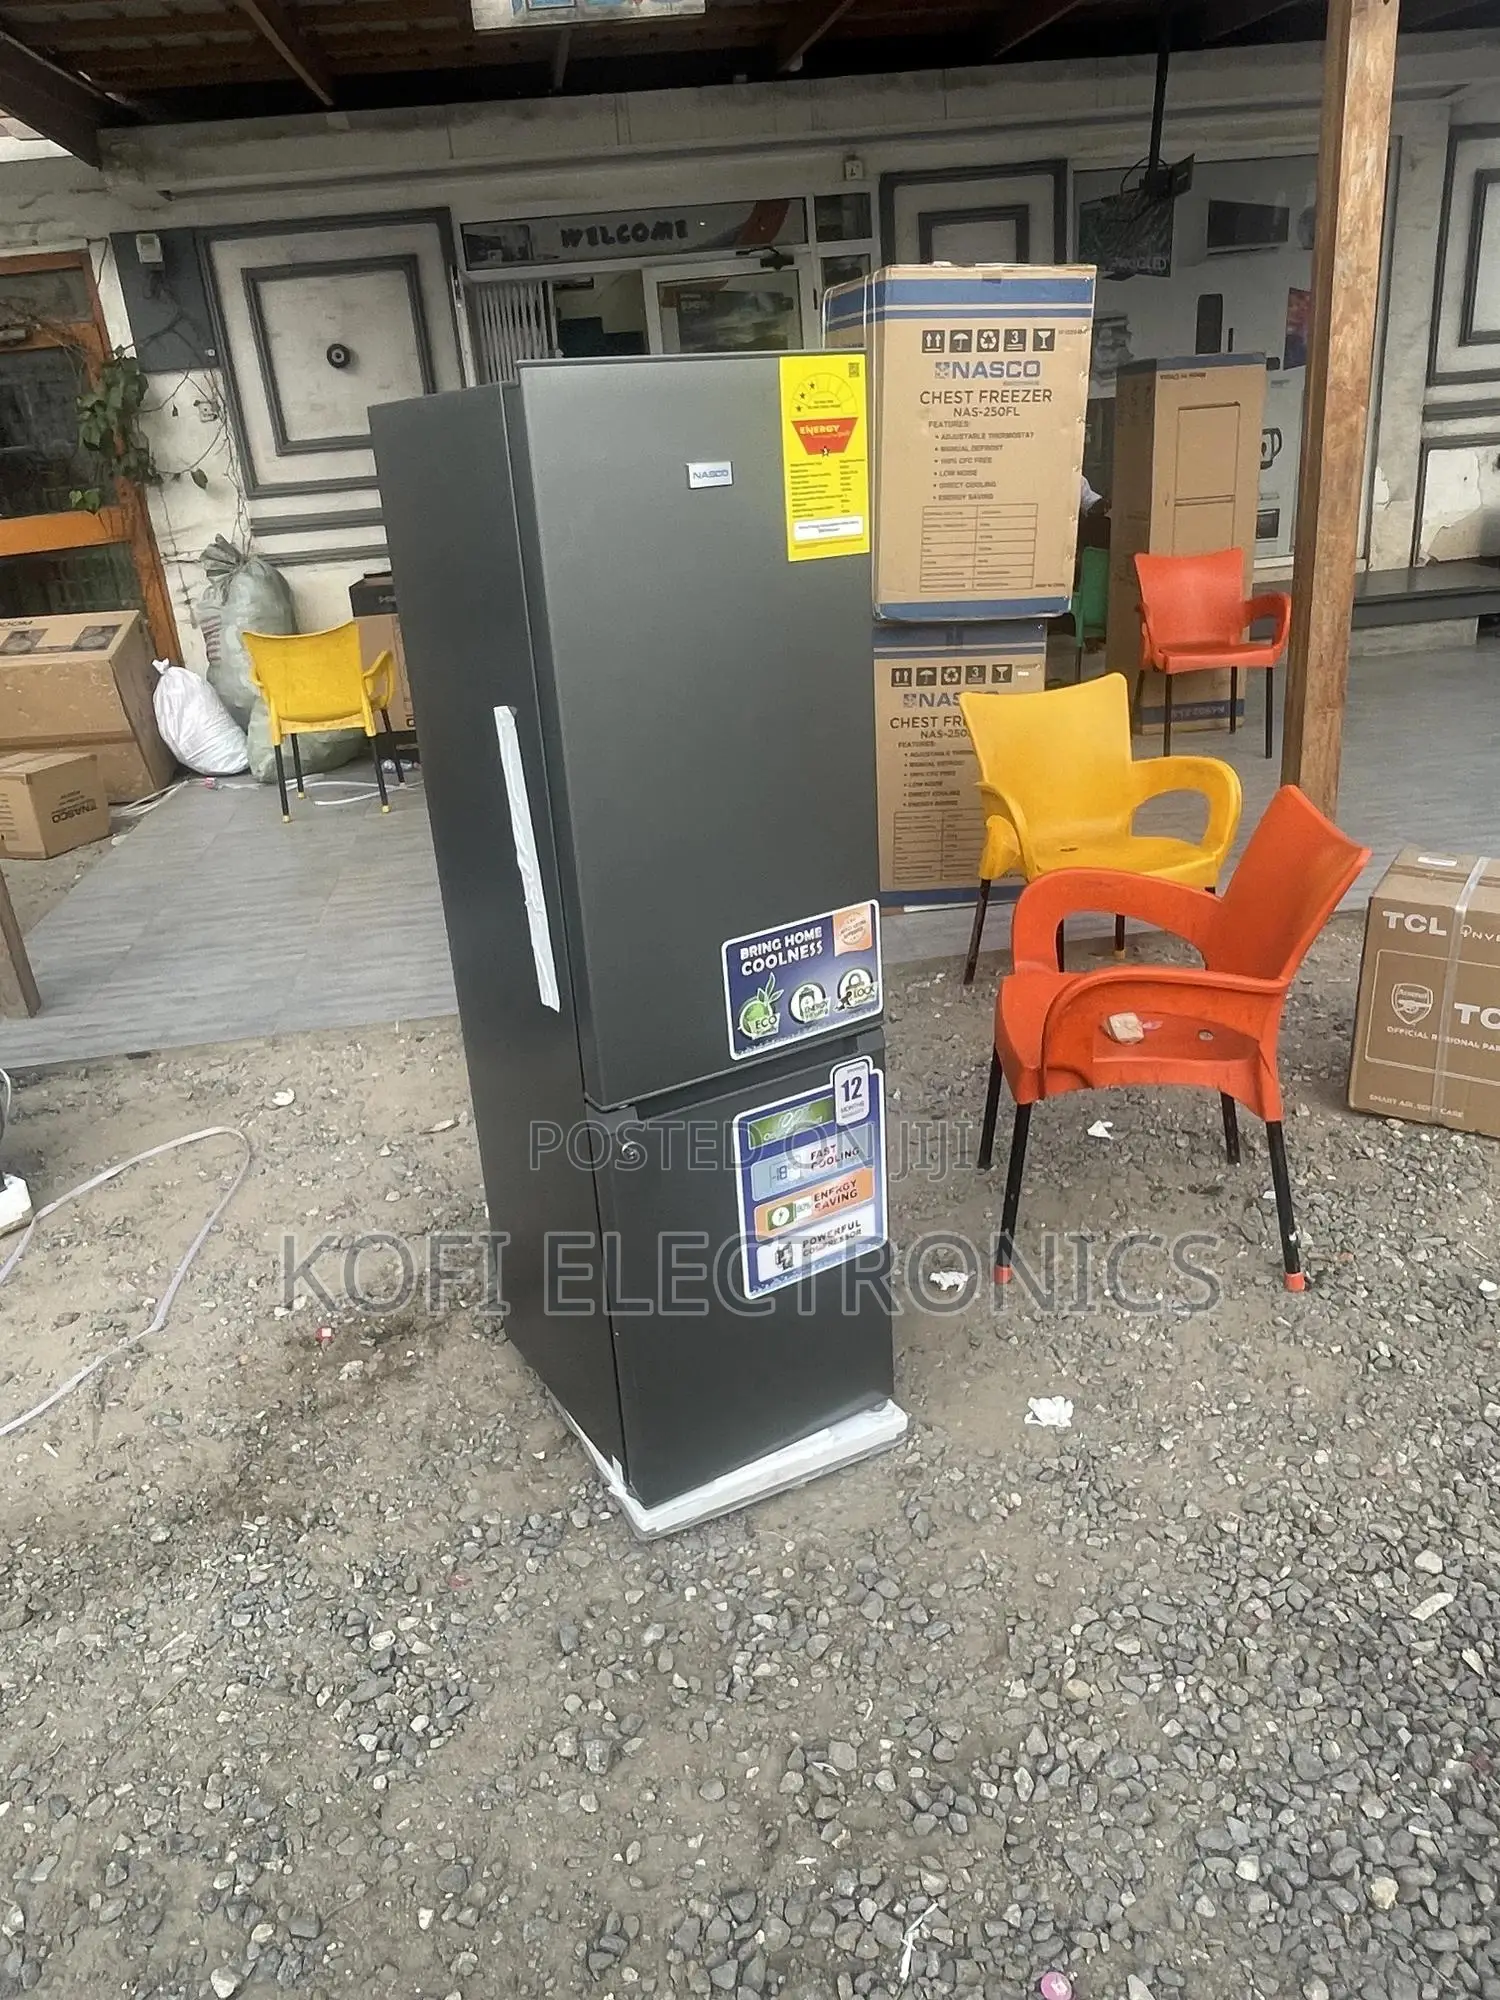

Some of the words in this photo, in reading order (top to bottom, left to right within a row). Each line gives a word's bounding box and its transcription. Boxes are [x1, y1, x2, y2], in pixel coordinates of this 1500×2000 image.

[560, 219, 688, 248] WELCOME
[952, 360, 1041, 379] NASCO
[920, 390, 974, 405] CHEST
[979, 388, 1053, 403] FREEZER
[953, 406, 1021, 418] NAS-250FL
[799, 424, 841, 436] ENERGY
[693, 469, 729, 480] NASCO
[890, 716, 938, 729] CHEST
[1382, 910, 1447, 936] TCL
[740, 938, 781, 960] BRING
[784, 926, 823, 947] HOME
[741, 940, 823, 976] COOLNESS
[755, 1015, 777, 1029] ECO
[1386, 1026, 1429, 1040] OFFICIAL
[841, 1076, 863, 1102] 12
[1369, 1093, 1397, 1105] SMART
[811, 1144, 836, 1160] FAST
[811, 1147, 860, 1169] COOLING
[814, 1179, 857, 1201] ENERGY
[814, 1188, 858, 1211] SAVING
[802, 1219, 861, 1248] POWERFUL
